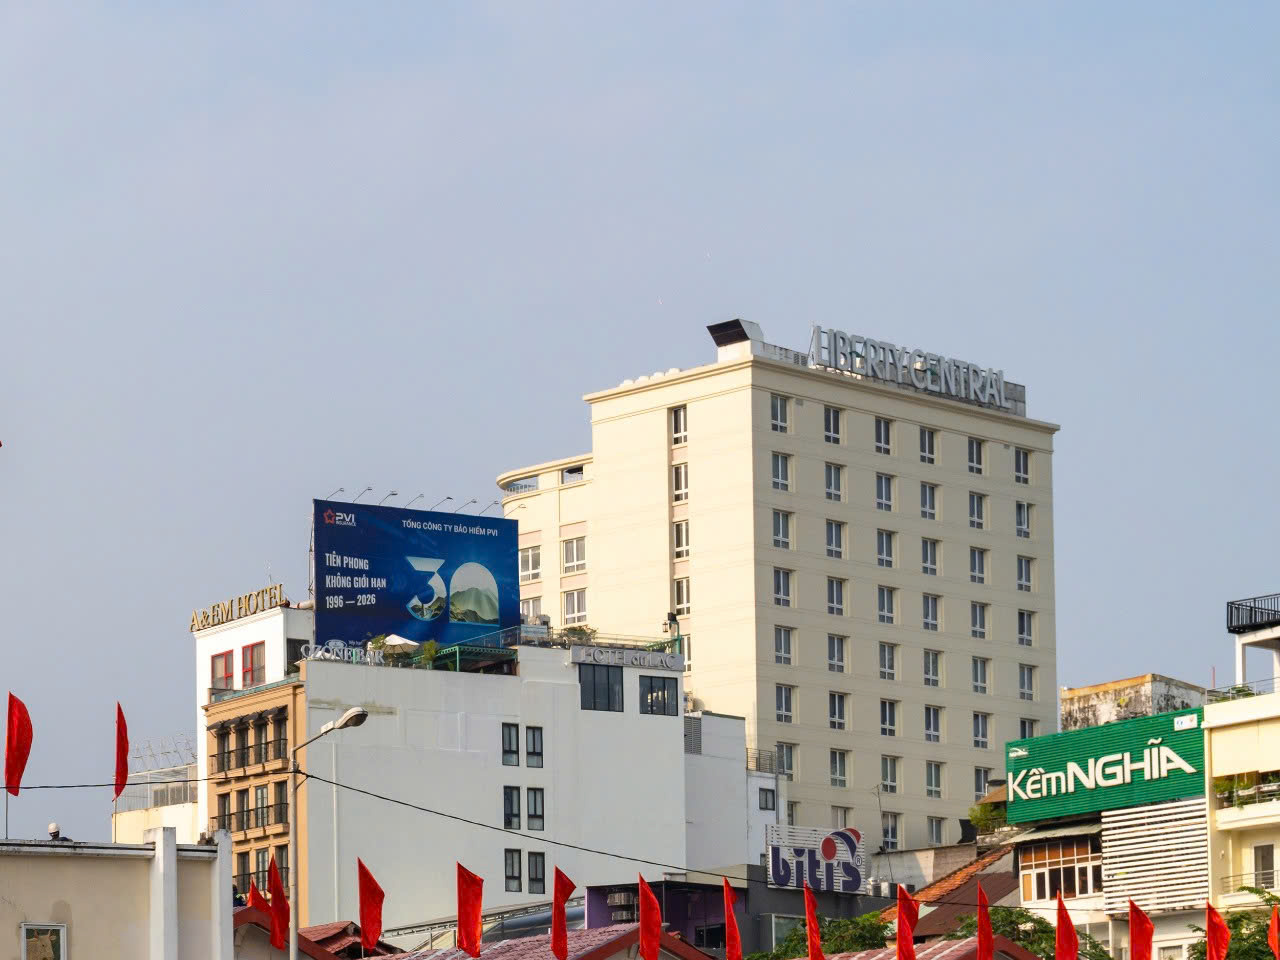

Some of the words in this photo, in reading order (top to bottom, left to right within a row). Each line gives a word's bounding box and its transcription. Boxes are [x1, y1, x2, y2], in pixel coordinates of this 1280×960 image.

[813, 325, 908, 384] LIBERTY
[908, 349, 1013, 409] CENTRAL
[335, 512, 355, 523] PVI
[402, 519, 421, 529] TỔNG
[422, 521, 443, 531] CÔNG
[444, 524, 453, 533] TY
[454, 523, 468, 534] BẢO
[468, 524, 486, 536] HIỂM
[487, 527, 498, 536] PVI
[325, 550, 342, 568] TIÊN
[343, 556, 369, 571] PHONG
[325, 573, 352, 588] KHÔNG
[353, 575, 369, 588] GIỚI
[371, 578, 387, 590] HẠN
[189, 599, 234, 632] A&EM
[236, 583, 288, 618] HOTEL
[325, 595, 344, 609] 1996
[356, 593, 376, 606] 2026
[301, 643, 353, 662] OZONE
[581, 648, 631, 666] HOTEL
[649, 653, 676, 670] LAC
